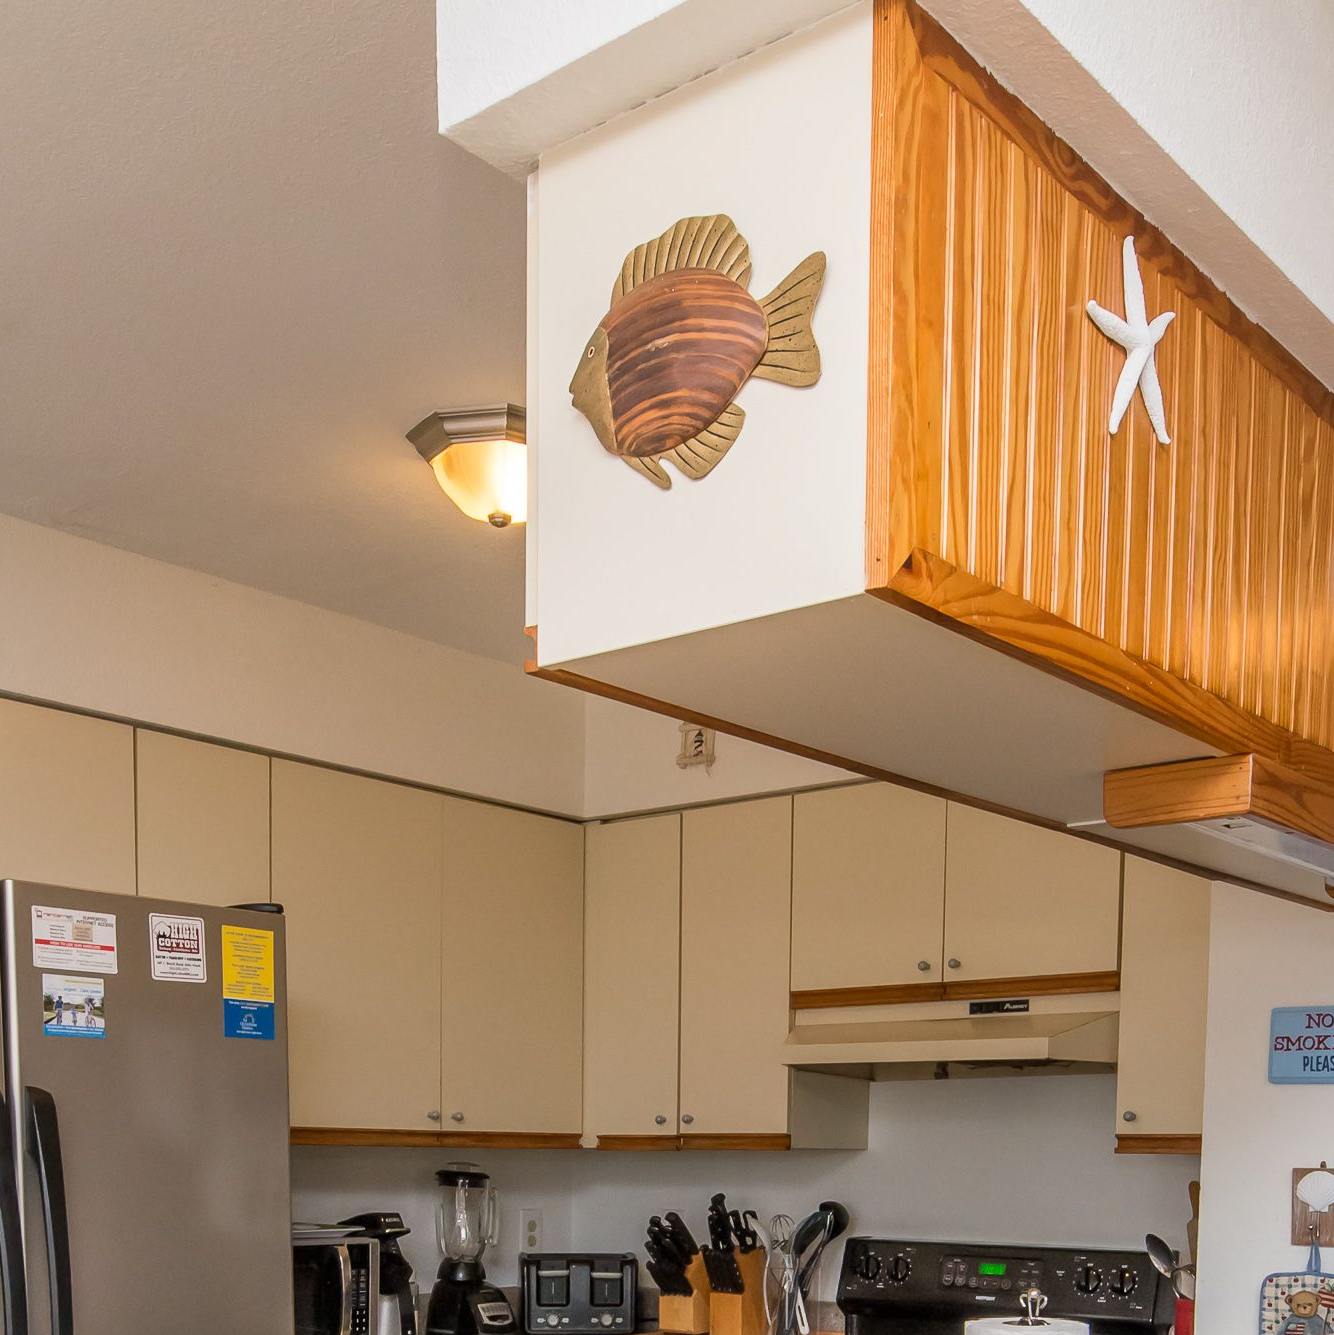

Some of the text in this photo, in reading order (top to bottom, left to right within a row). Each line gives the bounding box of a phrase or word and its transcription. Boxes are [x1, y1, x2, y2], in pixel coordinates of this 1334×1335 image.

[171, 922, 198, 940] HIGH
[158, 938, 198, 948] COTTON
[1305, 1013, 1334, 1029] NO
